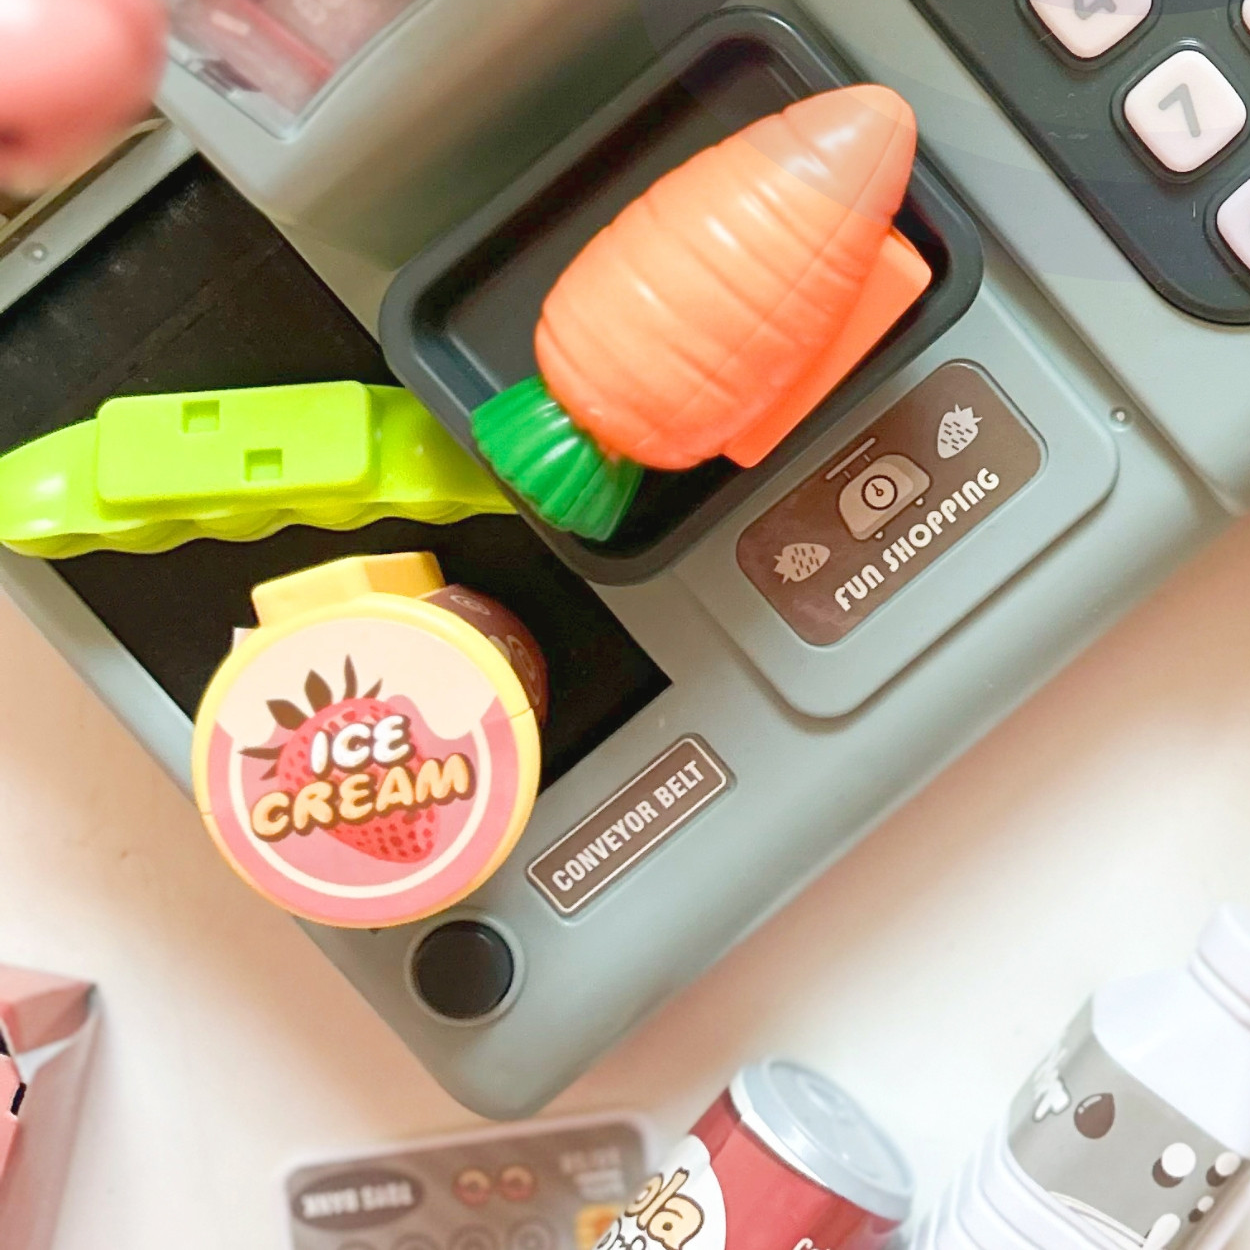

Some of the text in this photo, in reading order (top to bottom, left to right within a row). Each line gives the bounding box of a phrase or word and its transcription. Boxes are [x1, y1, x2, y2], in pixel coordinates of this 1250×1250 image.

[1157, 82, 1203, 139] 7
[834, 468, 999, 611] FUN SHOPPING
[310, 714, 412, 776] ICE
[251, 753, 472, 839] CREAM
[552, 760, 704, 891] CONVEYOR BELT
